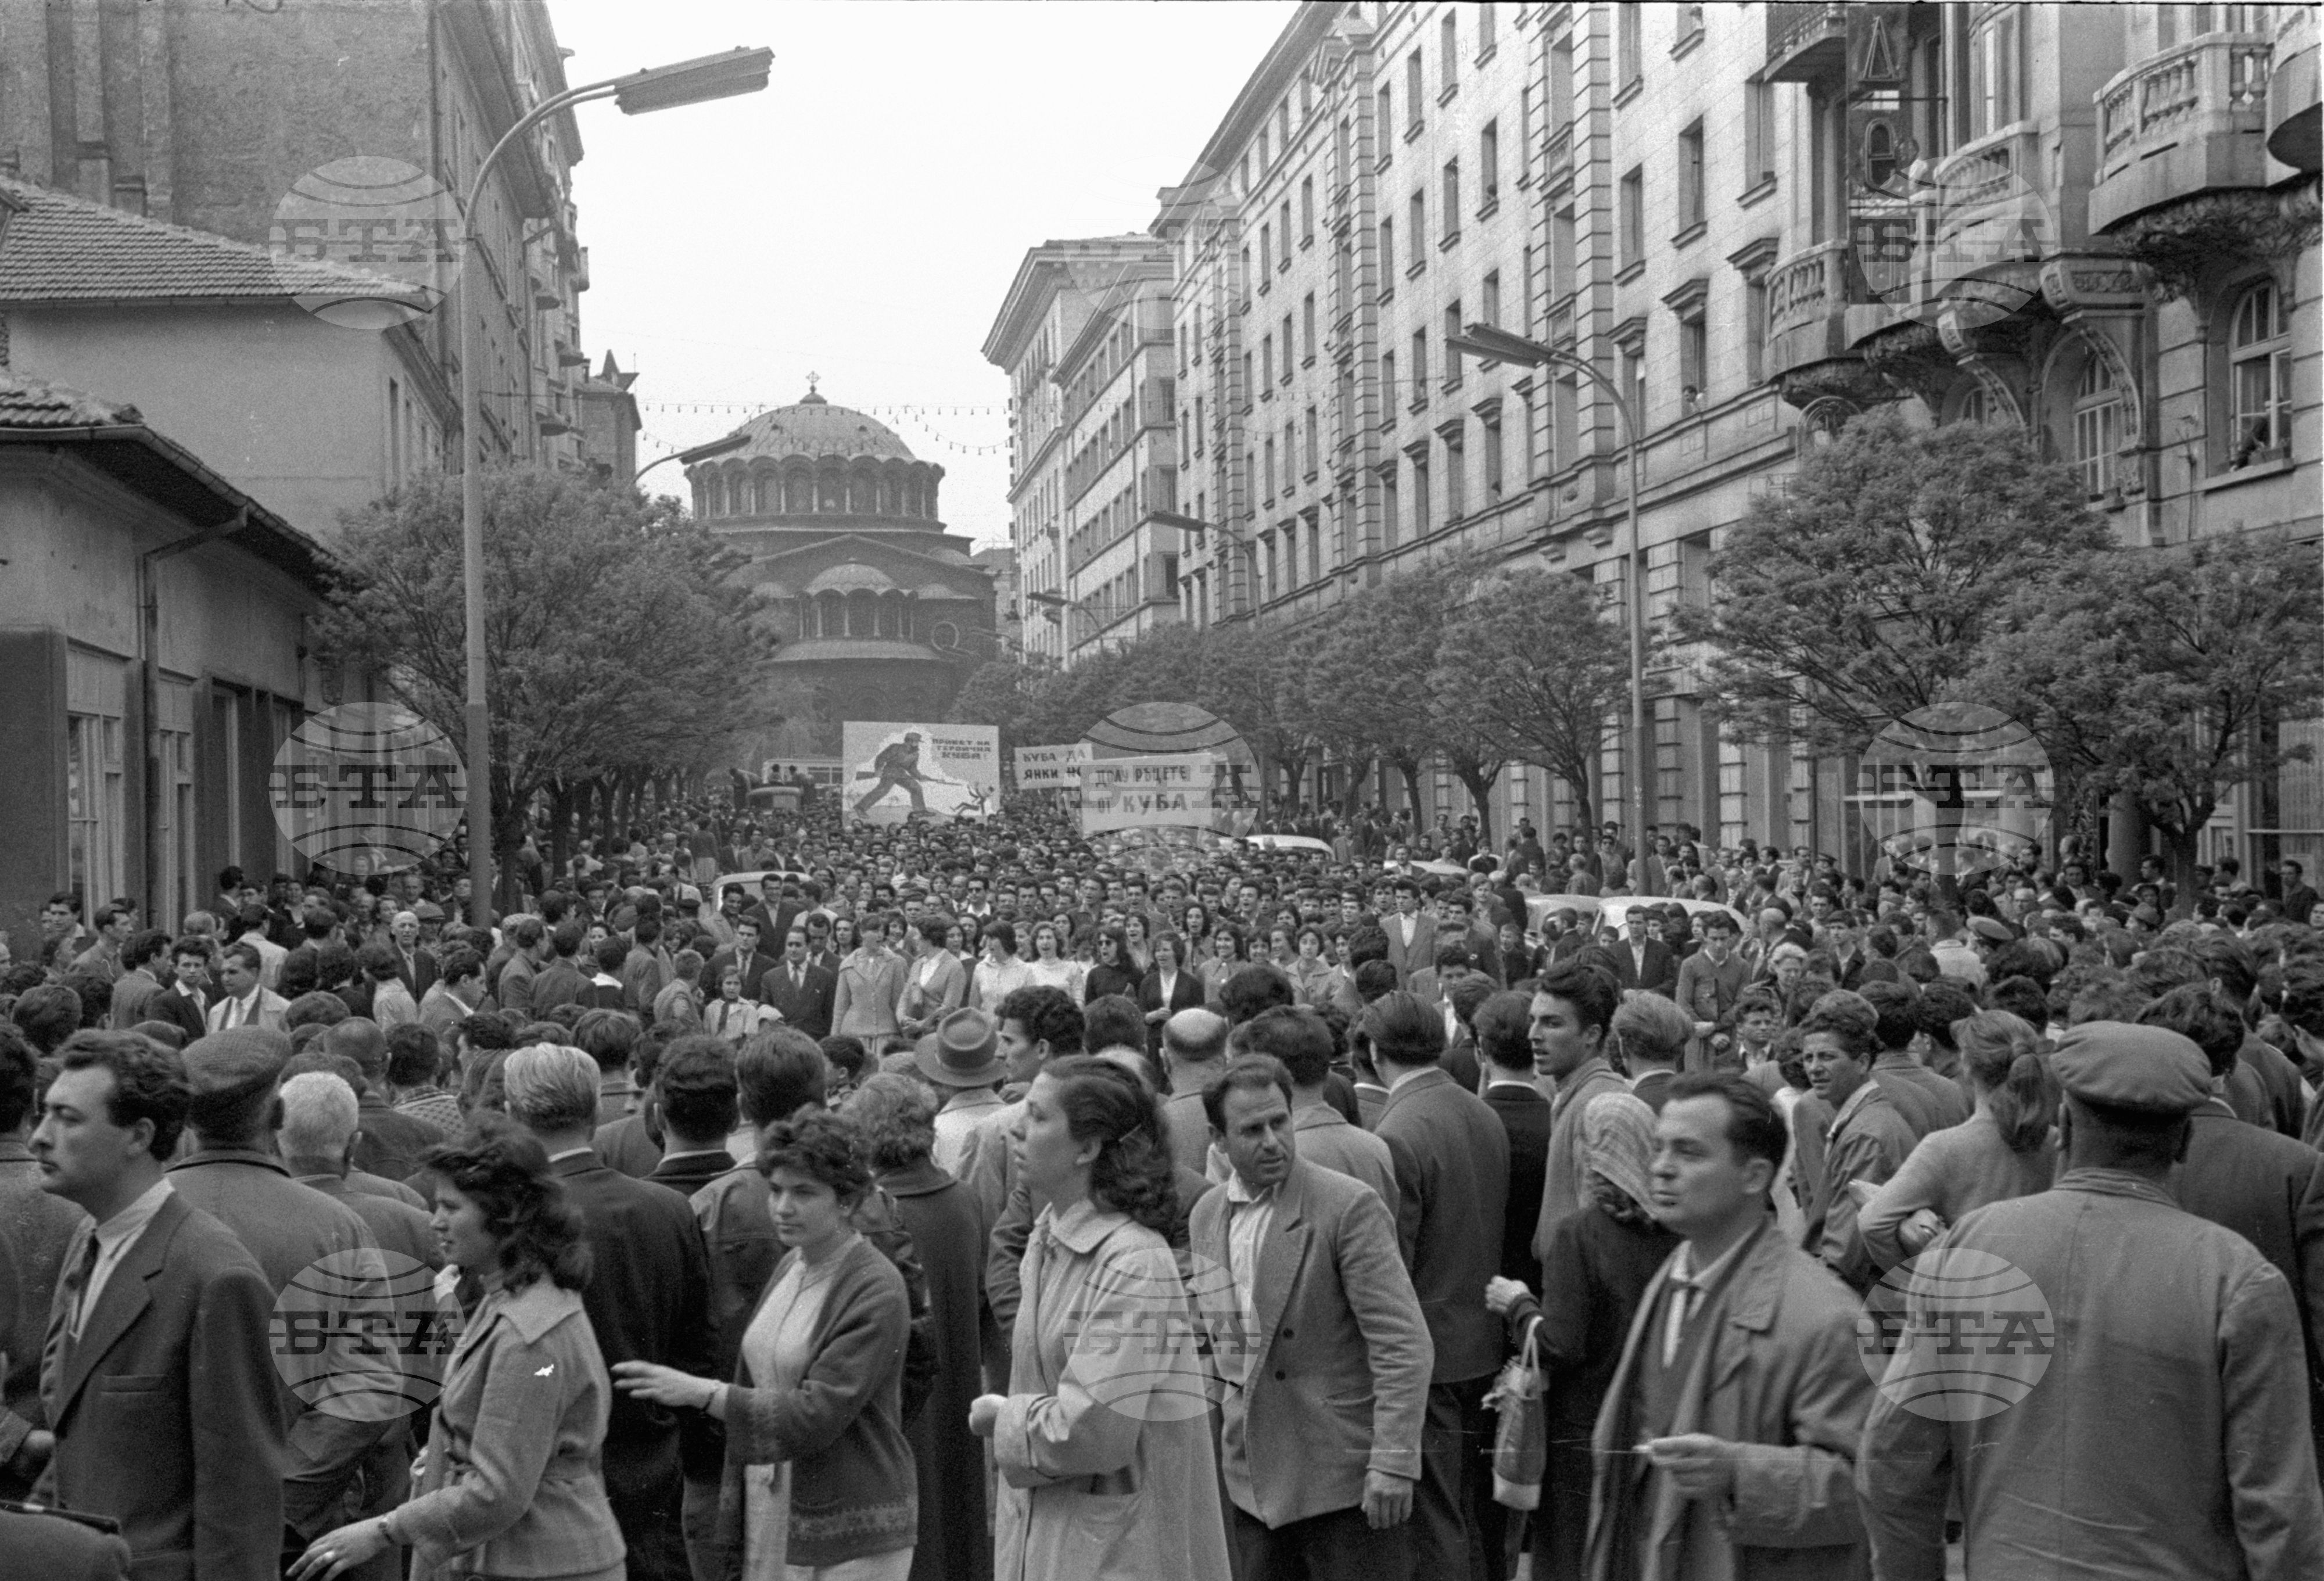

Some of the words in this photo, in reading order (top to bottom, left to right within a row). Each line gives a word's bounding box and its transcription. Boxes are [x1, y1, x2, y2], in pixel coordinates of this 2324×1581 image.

[1023, 752, 1056, 762] КУБА
[1023, 769, 1059, 780] ЯНКИ
[1095, 768, 1129, 787] ДОЛУ
[1135, 766, 1188, 784] РЪЦЕТЕ
[1097, 796, 1113, 814] ОТ
[1122, 793, 1188, 815] КУБА
